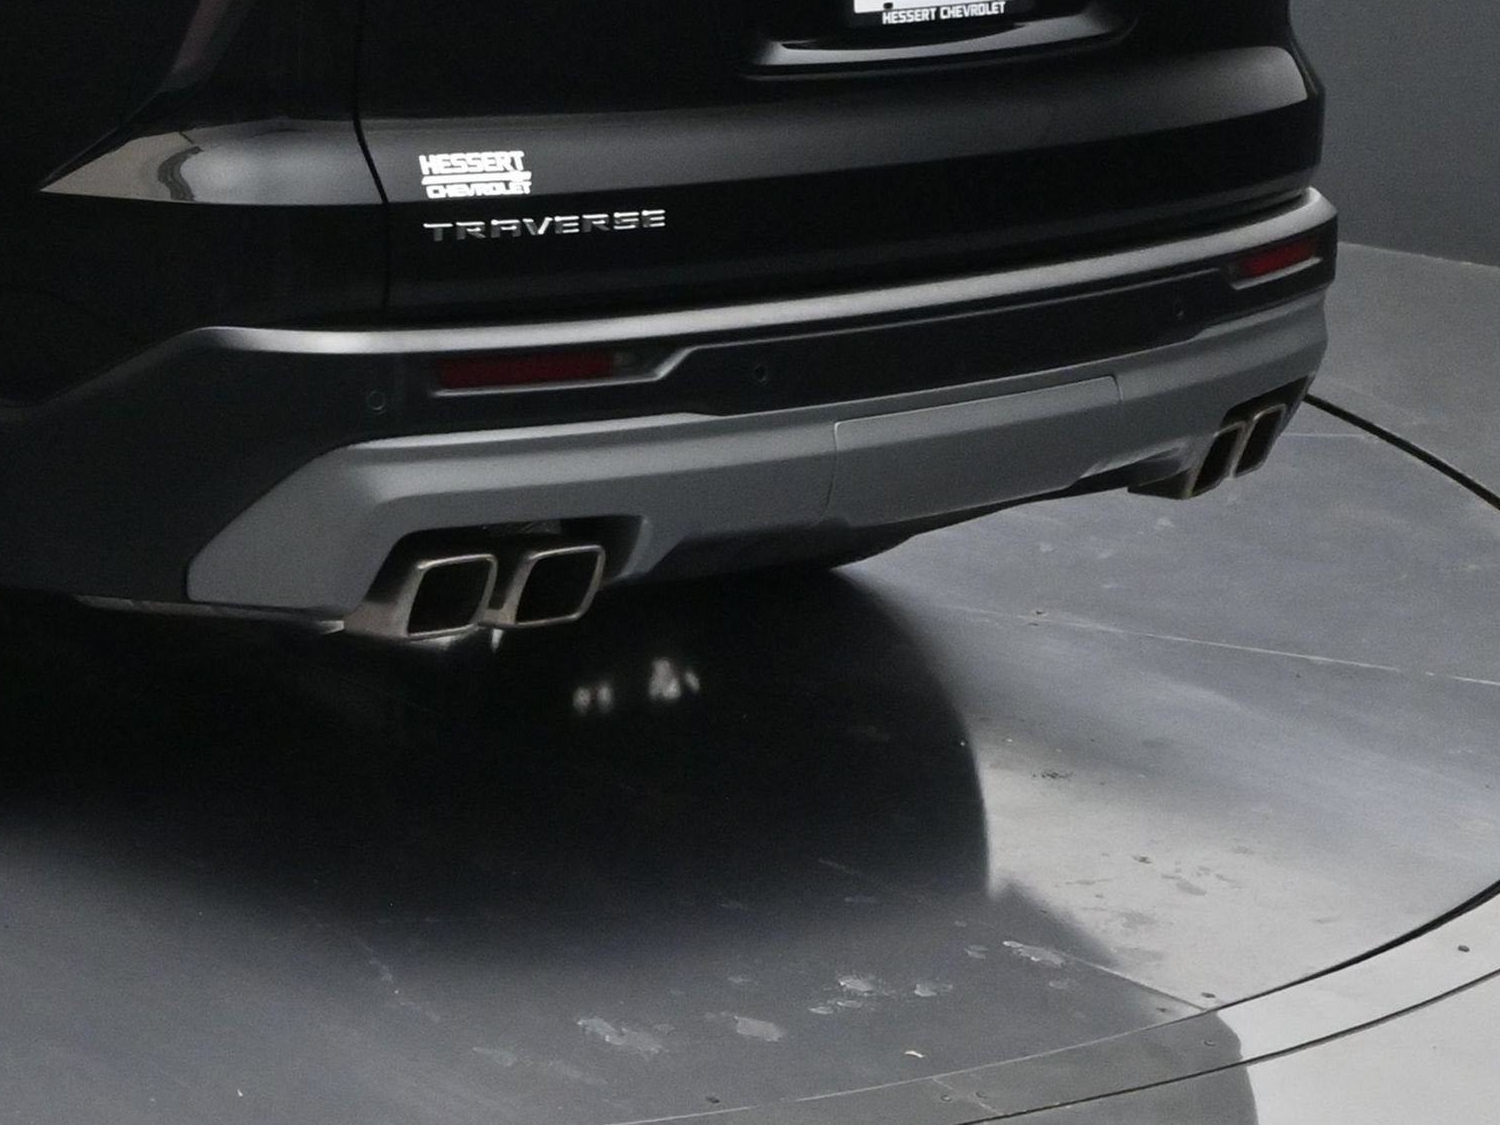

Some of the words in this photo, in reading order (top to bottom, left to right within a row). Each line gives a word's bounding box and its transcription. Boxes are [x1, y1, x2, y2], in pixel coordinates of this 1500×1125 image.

[882, 8, 937, 25] HESSERT
[940, 1, 1006, 18] CHEVROLET
[419, 150, 525, 175] HESSERT
[426, 181, 532, 198] CHEVROLET
[423, 209, 666, 242] TRAVERSE
